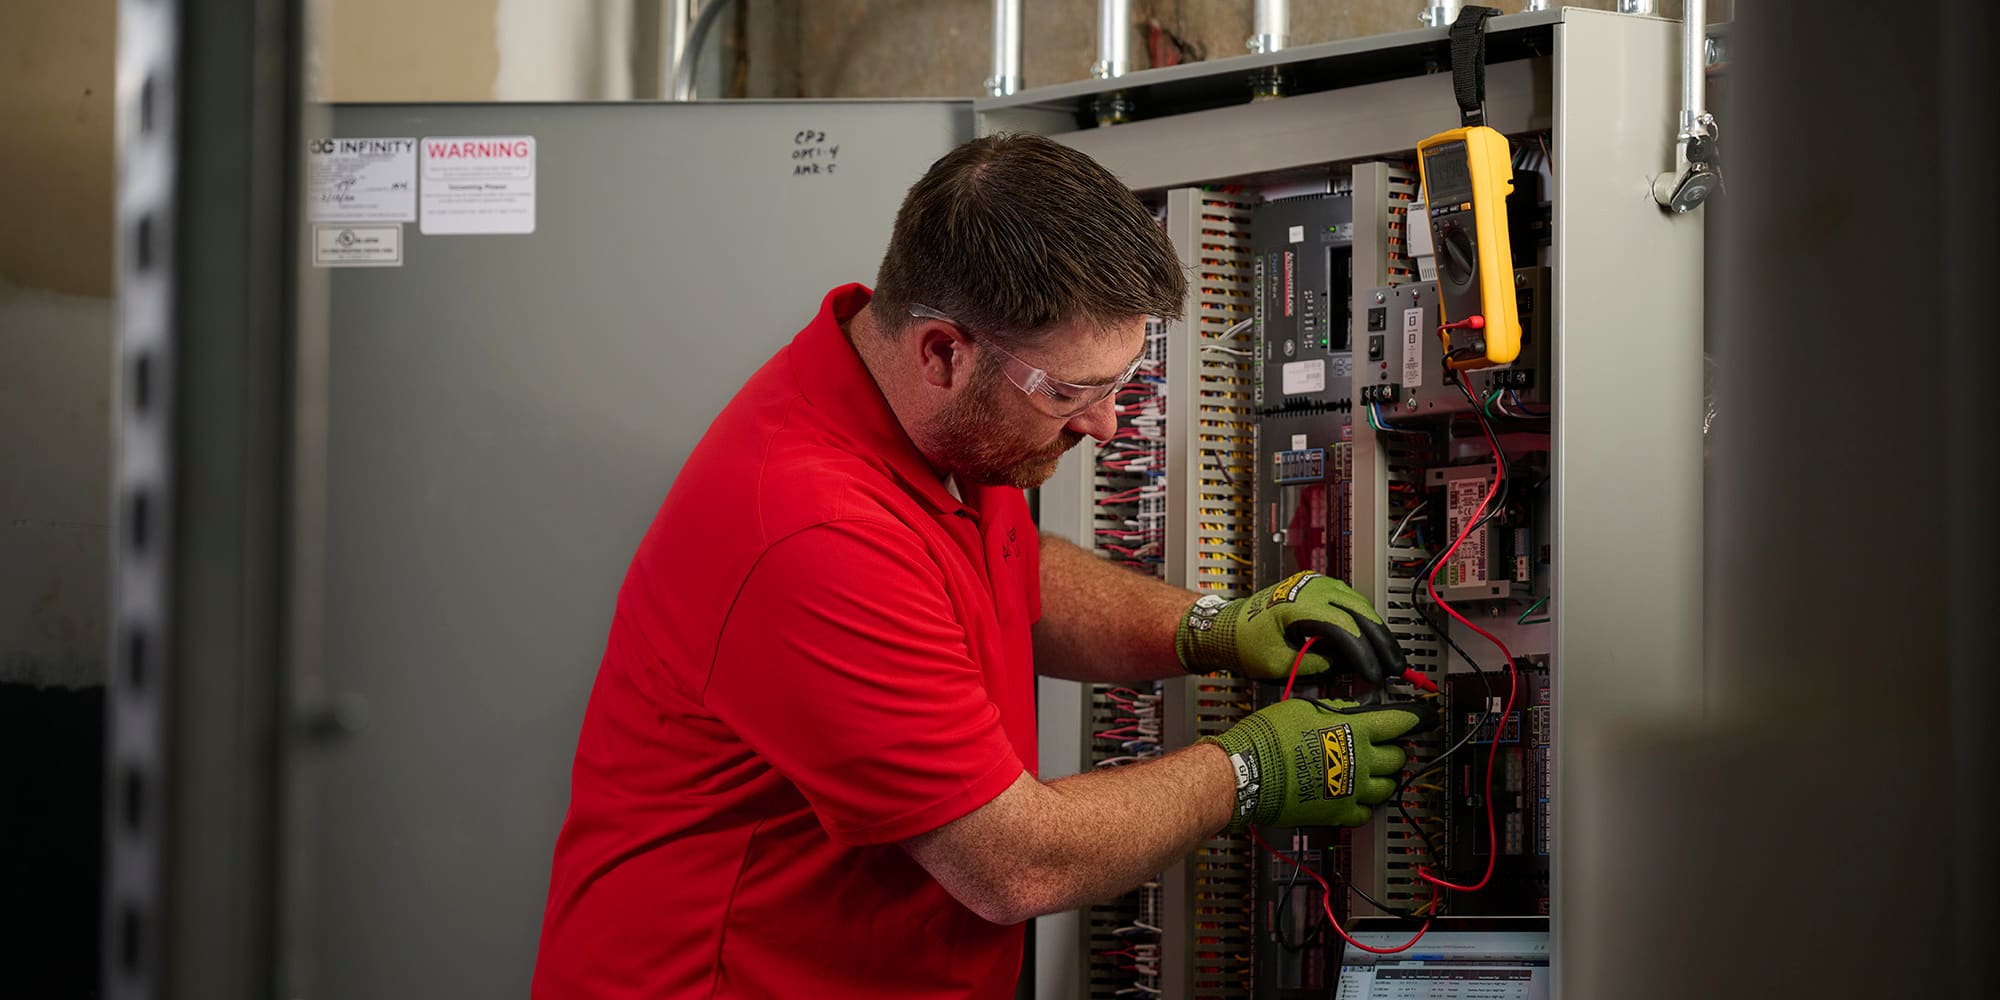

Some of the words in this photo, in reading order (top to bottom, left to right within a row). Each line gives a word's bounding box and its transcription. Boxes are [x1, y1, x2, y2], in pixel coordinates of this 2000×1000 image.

[794, 130, 825, 144] CP2
[340, 140, 413, 153] INFINITY
[428, 141, 529, 159] WARNING
[1335, 729, 1347, 754] WEAR
